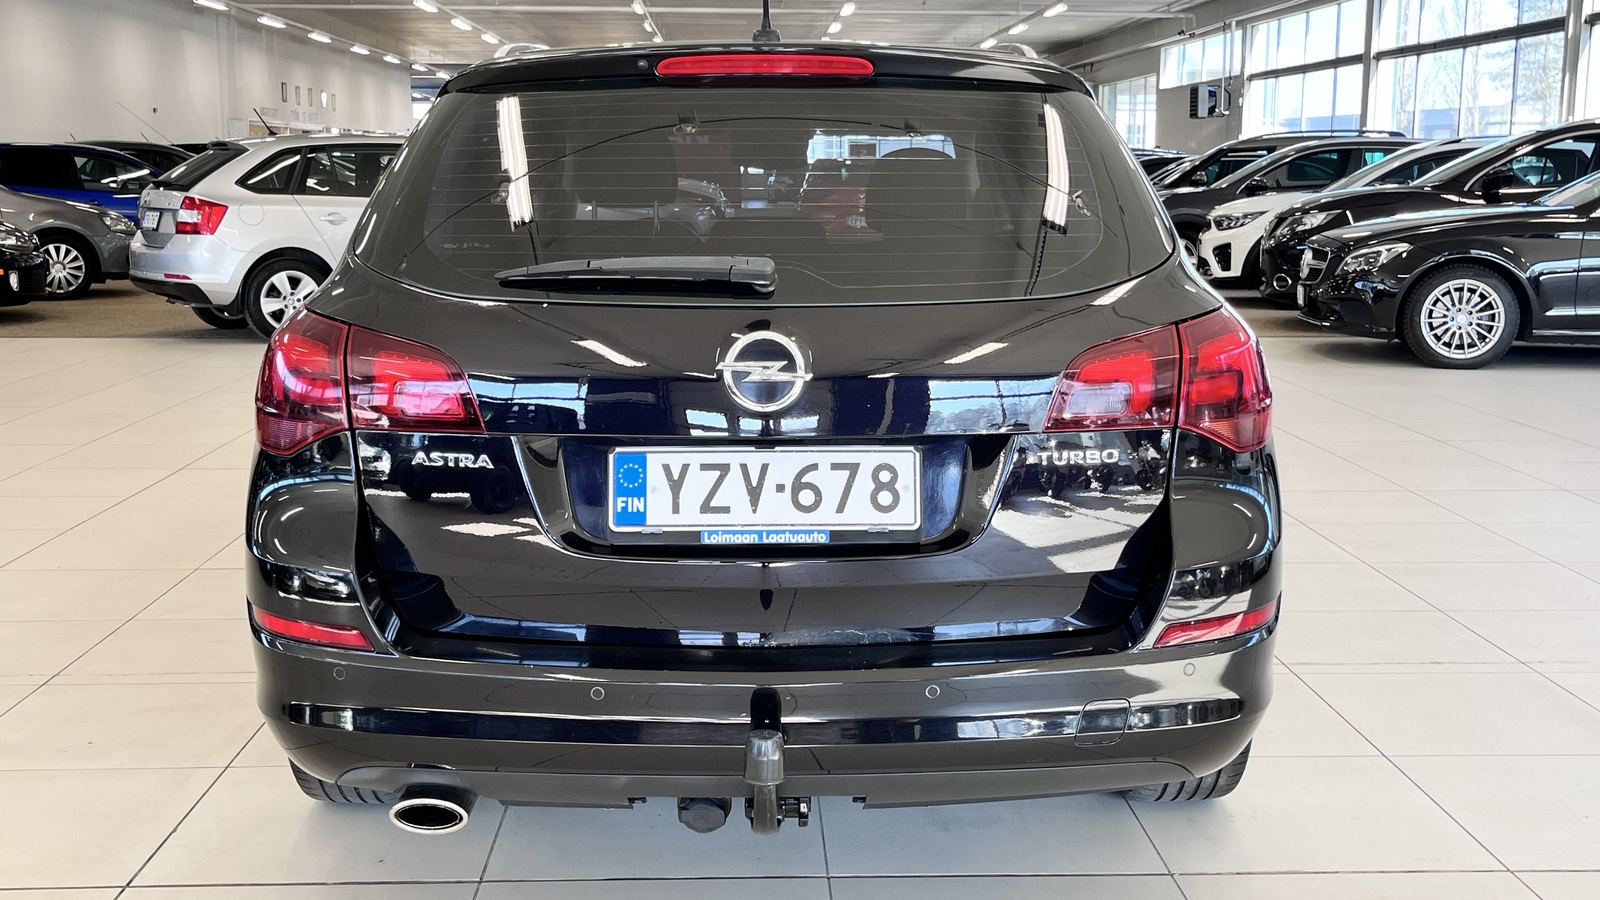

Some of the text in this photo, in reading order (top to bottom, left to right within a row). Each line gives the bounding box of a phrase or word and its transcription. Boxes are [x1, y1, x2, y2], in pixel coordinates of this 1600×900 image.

[411, 451, 495, 469] ASTRA
[1036, 449, 1120, 466] TURBO
[661, 463, 901, 514] YZV-678
[617, 497, 645, 513] FIN
[704, 531, 827, 543] Loimaan Laatuauto
